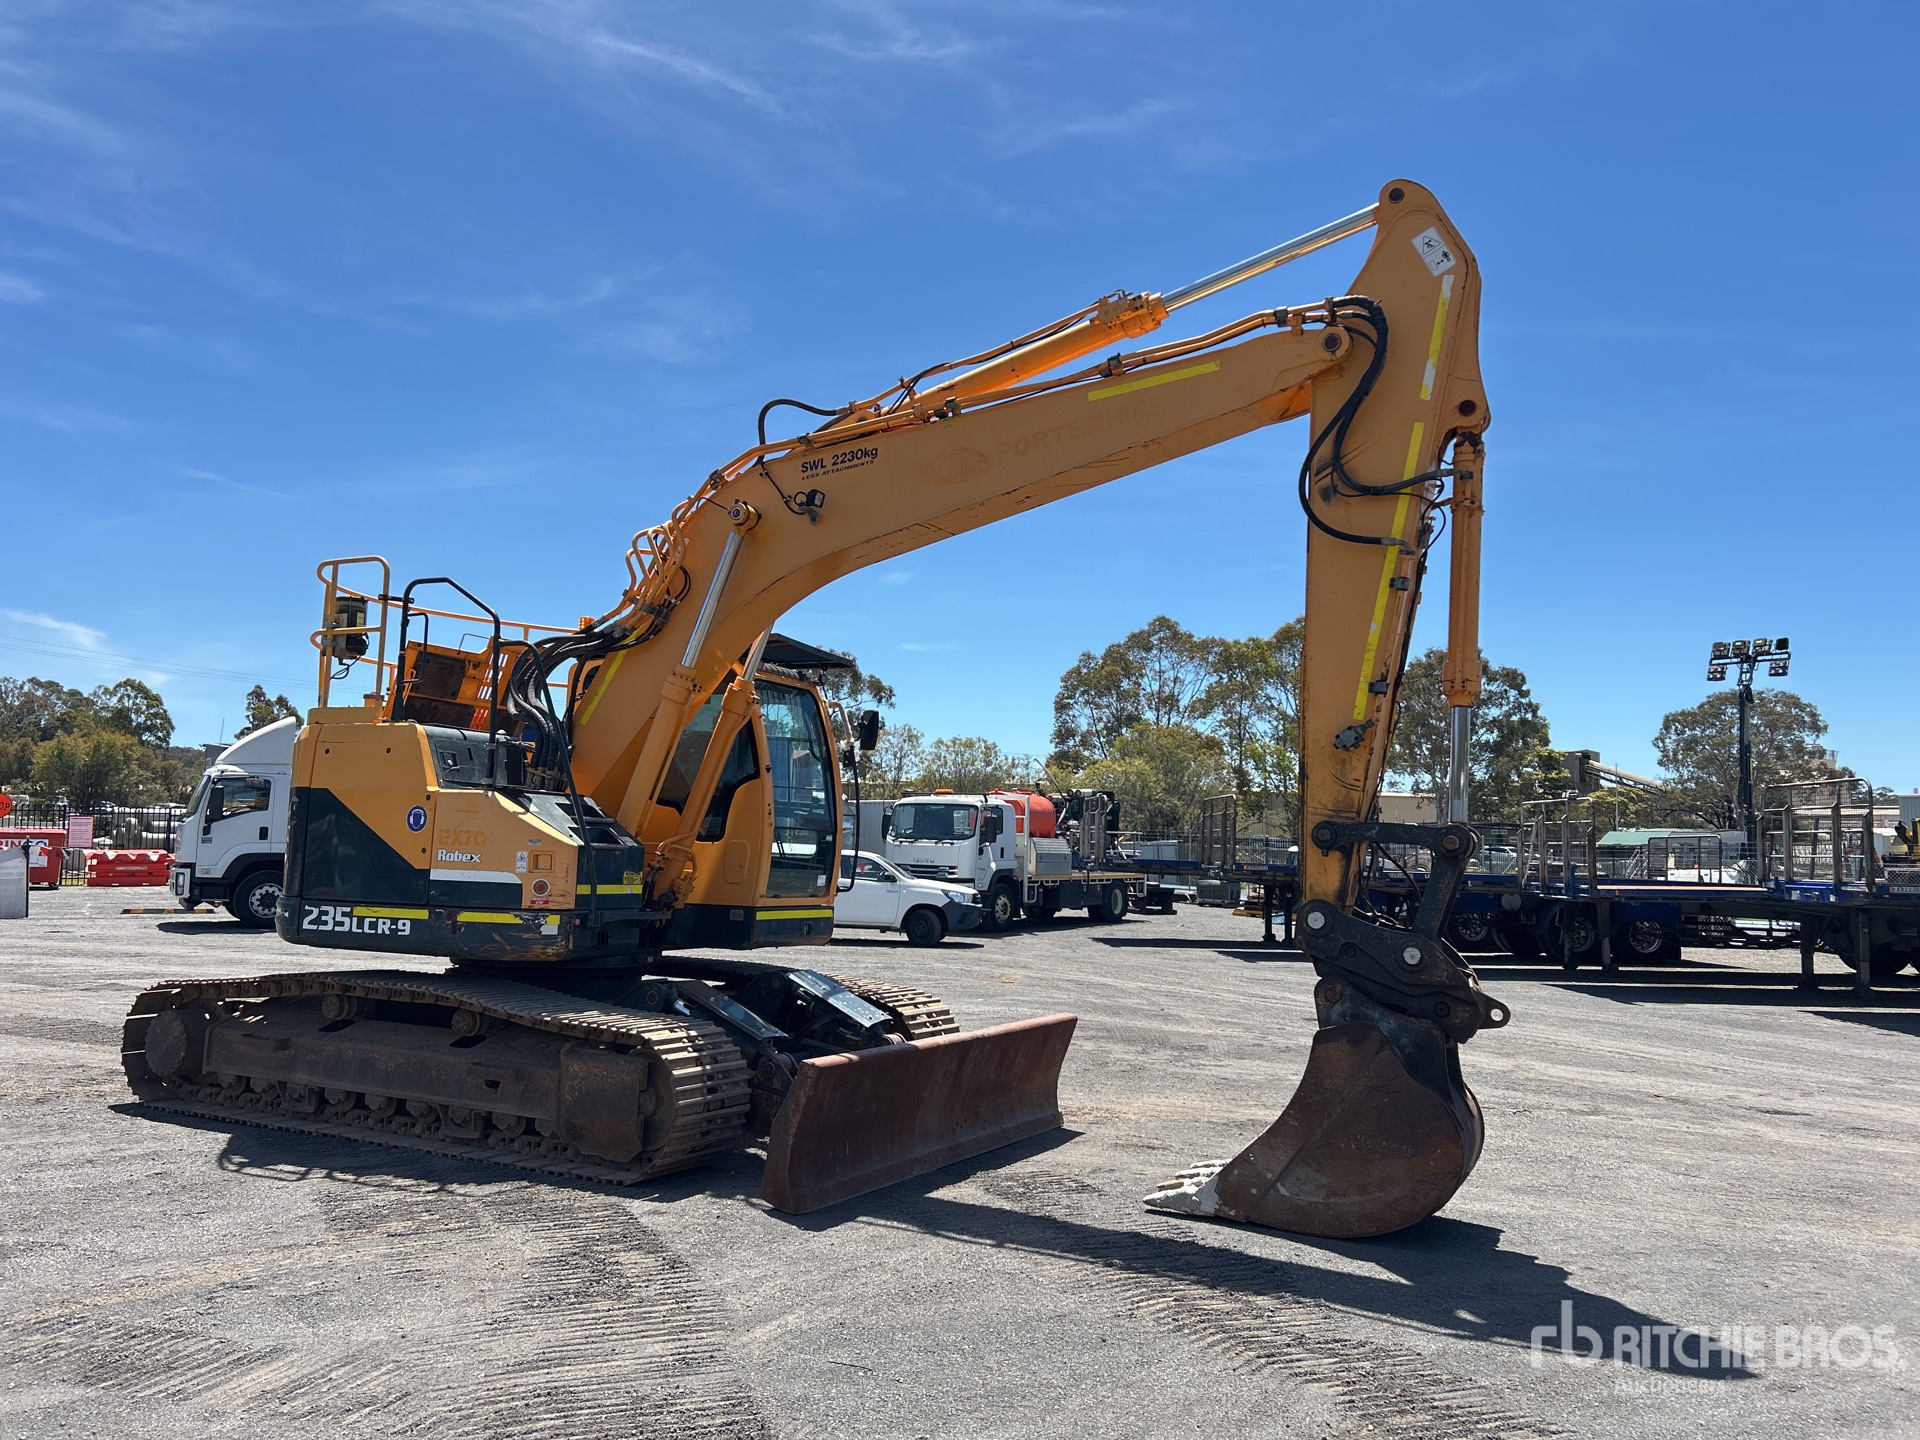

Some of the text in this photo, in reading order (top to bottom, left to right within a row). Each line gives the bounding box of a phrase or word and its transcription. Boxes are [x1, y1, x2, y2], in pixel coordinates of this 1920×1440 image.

[801, 447, 878, 473] SWL 2230kg
[822, 460, 875, 476] ATTACHMENTS
[437, 849, 483, 863] Robex
